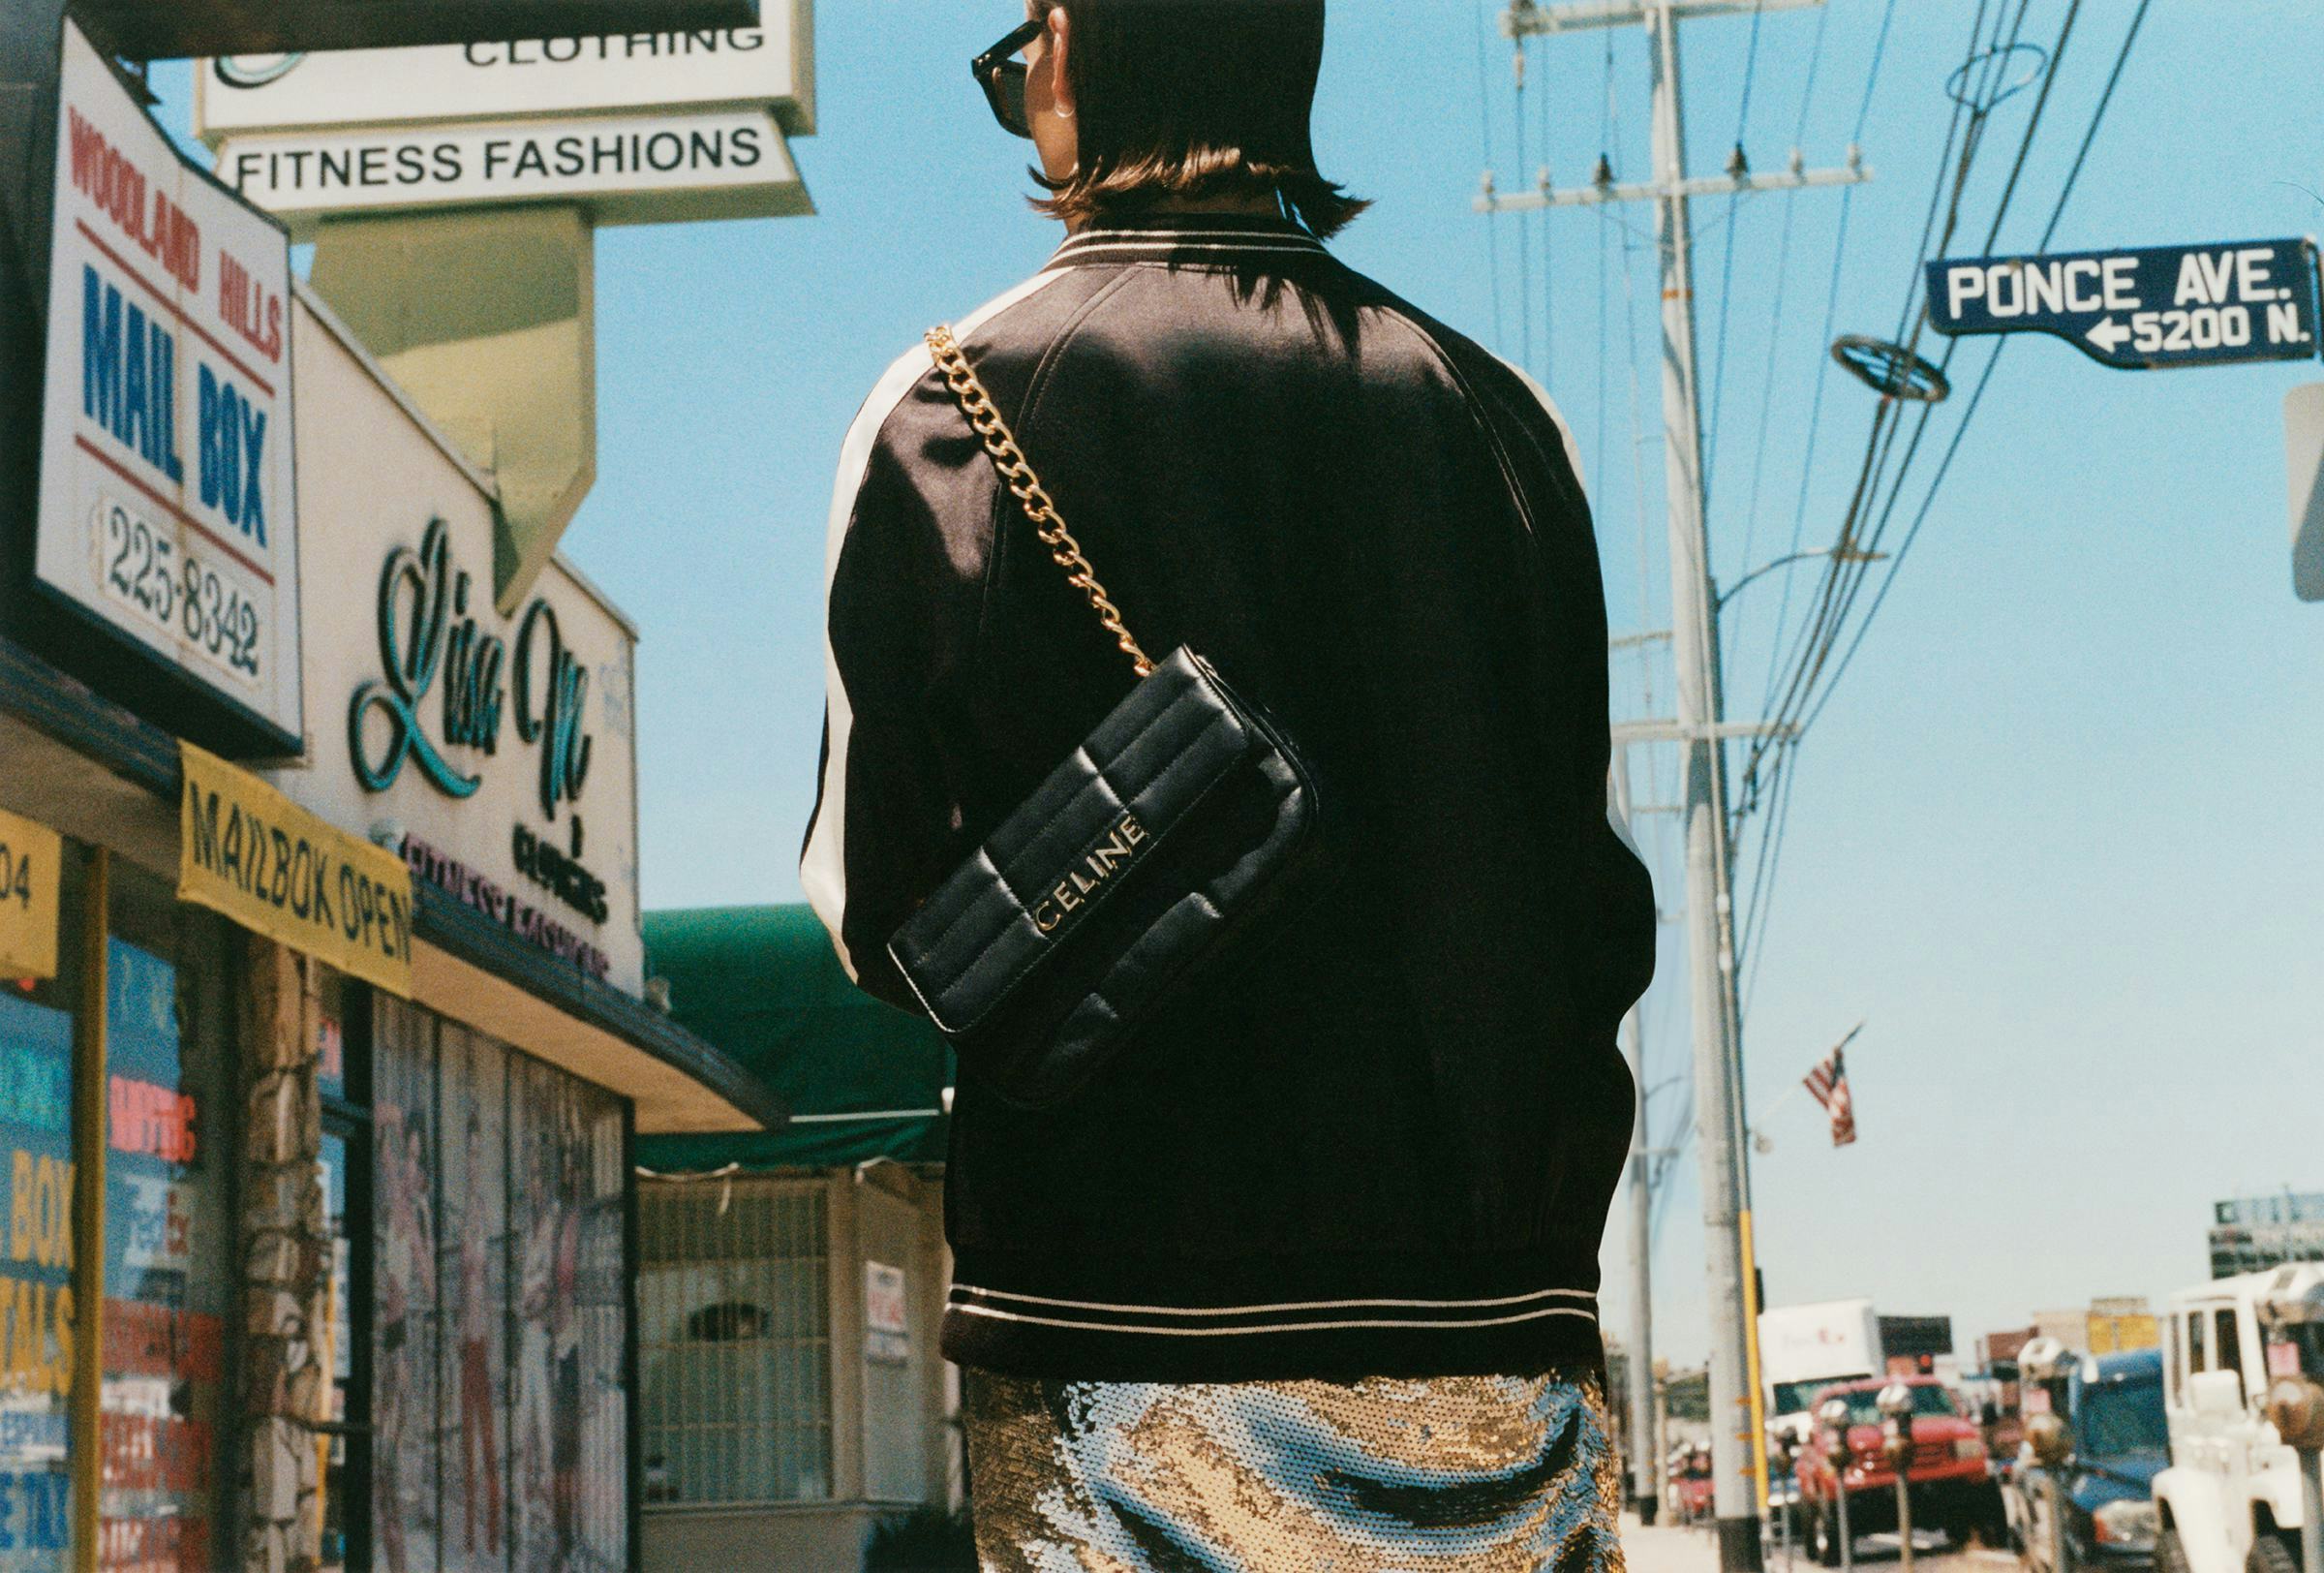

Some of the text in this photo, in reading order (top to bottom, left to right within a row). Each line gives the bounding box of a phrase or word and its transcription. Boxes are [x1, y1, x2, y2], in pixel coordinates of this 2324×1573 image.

[465, 27, 764, 67] CLOTHING
[236, 127, 760, 194] FITNESS FASHIONS
[69, 103, 282, 363] WOODLAND HILLS
[1947, 248, 2292, 320] PONCE AVE.
[2132, 302, 2310, 353] 5200 N.
[82, 262, 267, 548] MAIL BOX
[339, 861, 412, 965] OPEN
[1034, 815, 1149, 931] CELINE
